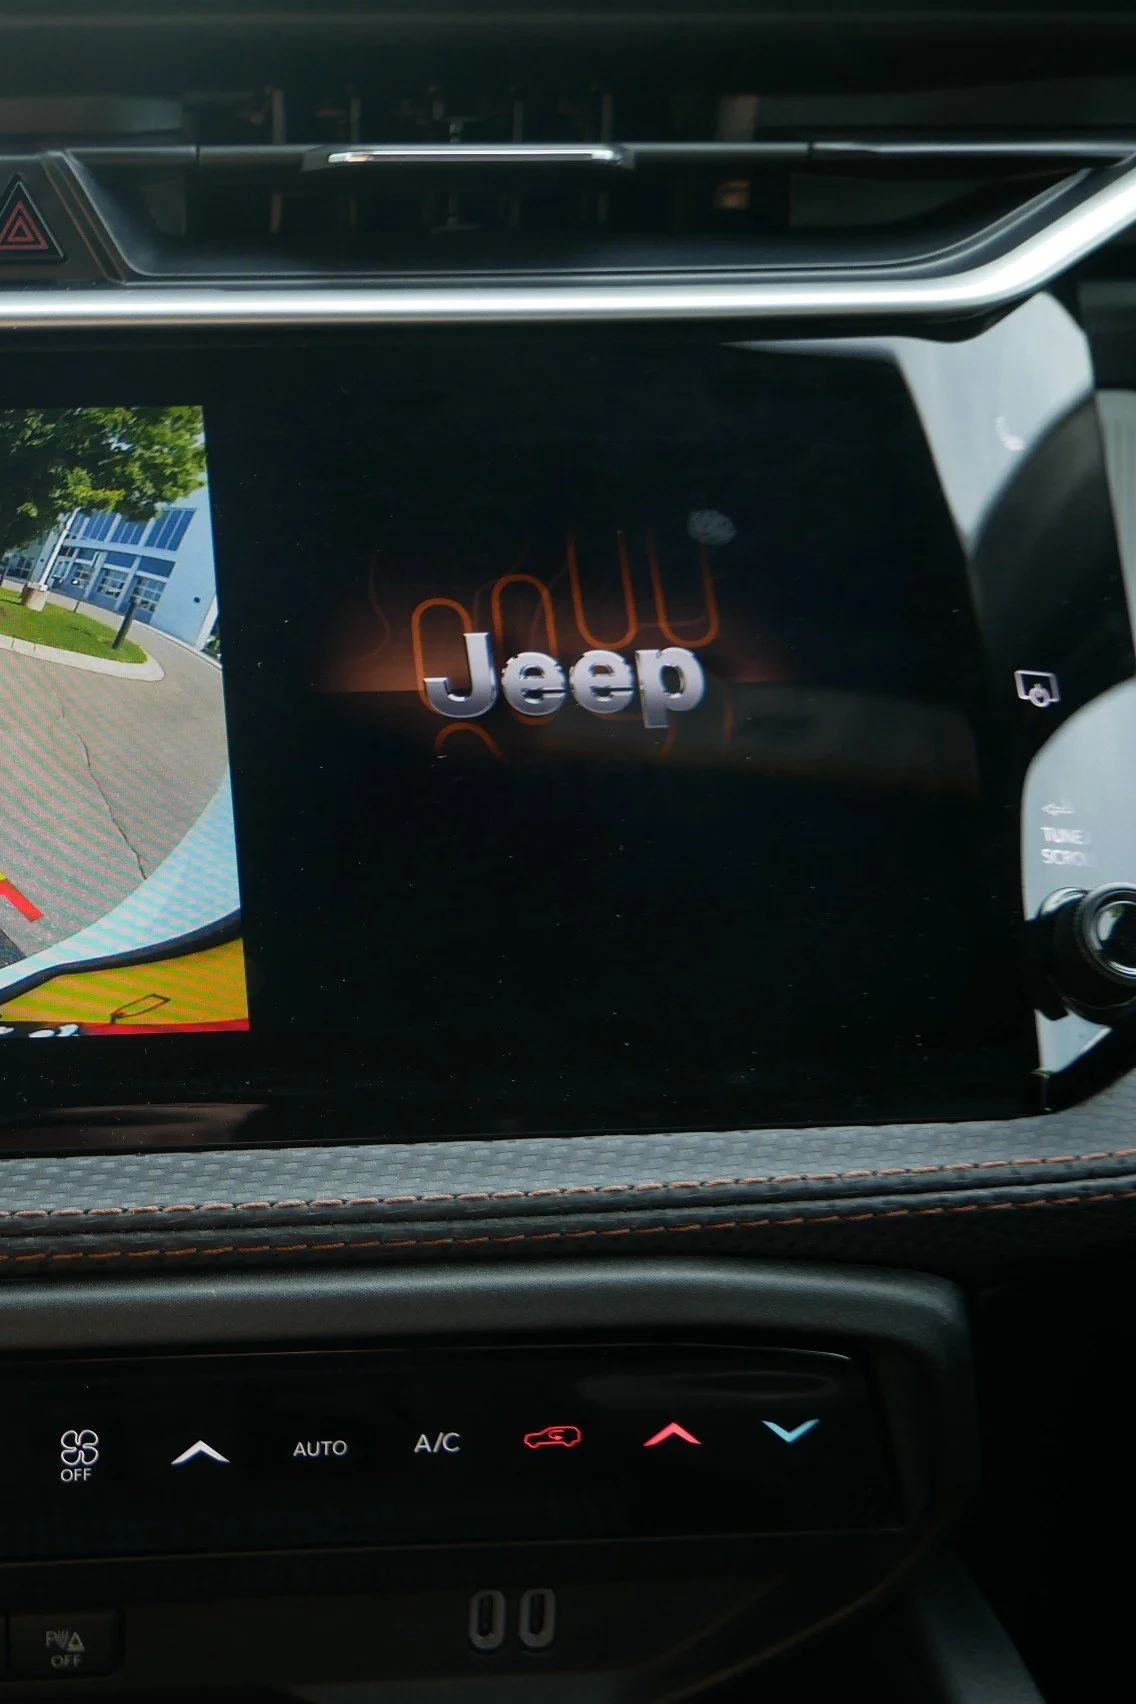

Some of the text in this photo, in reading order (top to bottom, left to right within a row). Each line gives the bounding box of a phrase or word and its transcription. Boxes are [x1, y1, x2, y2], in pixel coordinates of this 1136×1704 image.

[423, 632, 705, 728] Jeep
[293, 1440, 348, 1457] AUTO
[413, 1431, 461, 1454] A/C
[60, 1467, 91, 1482] OFF
[51, 1654, 82, 1669] OFF
